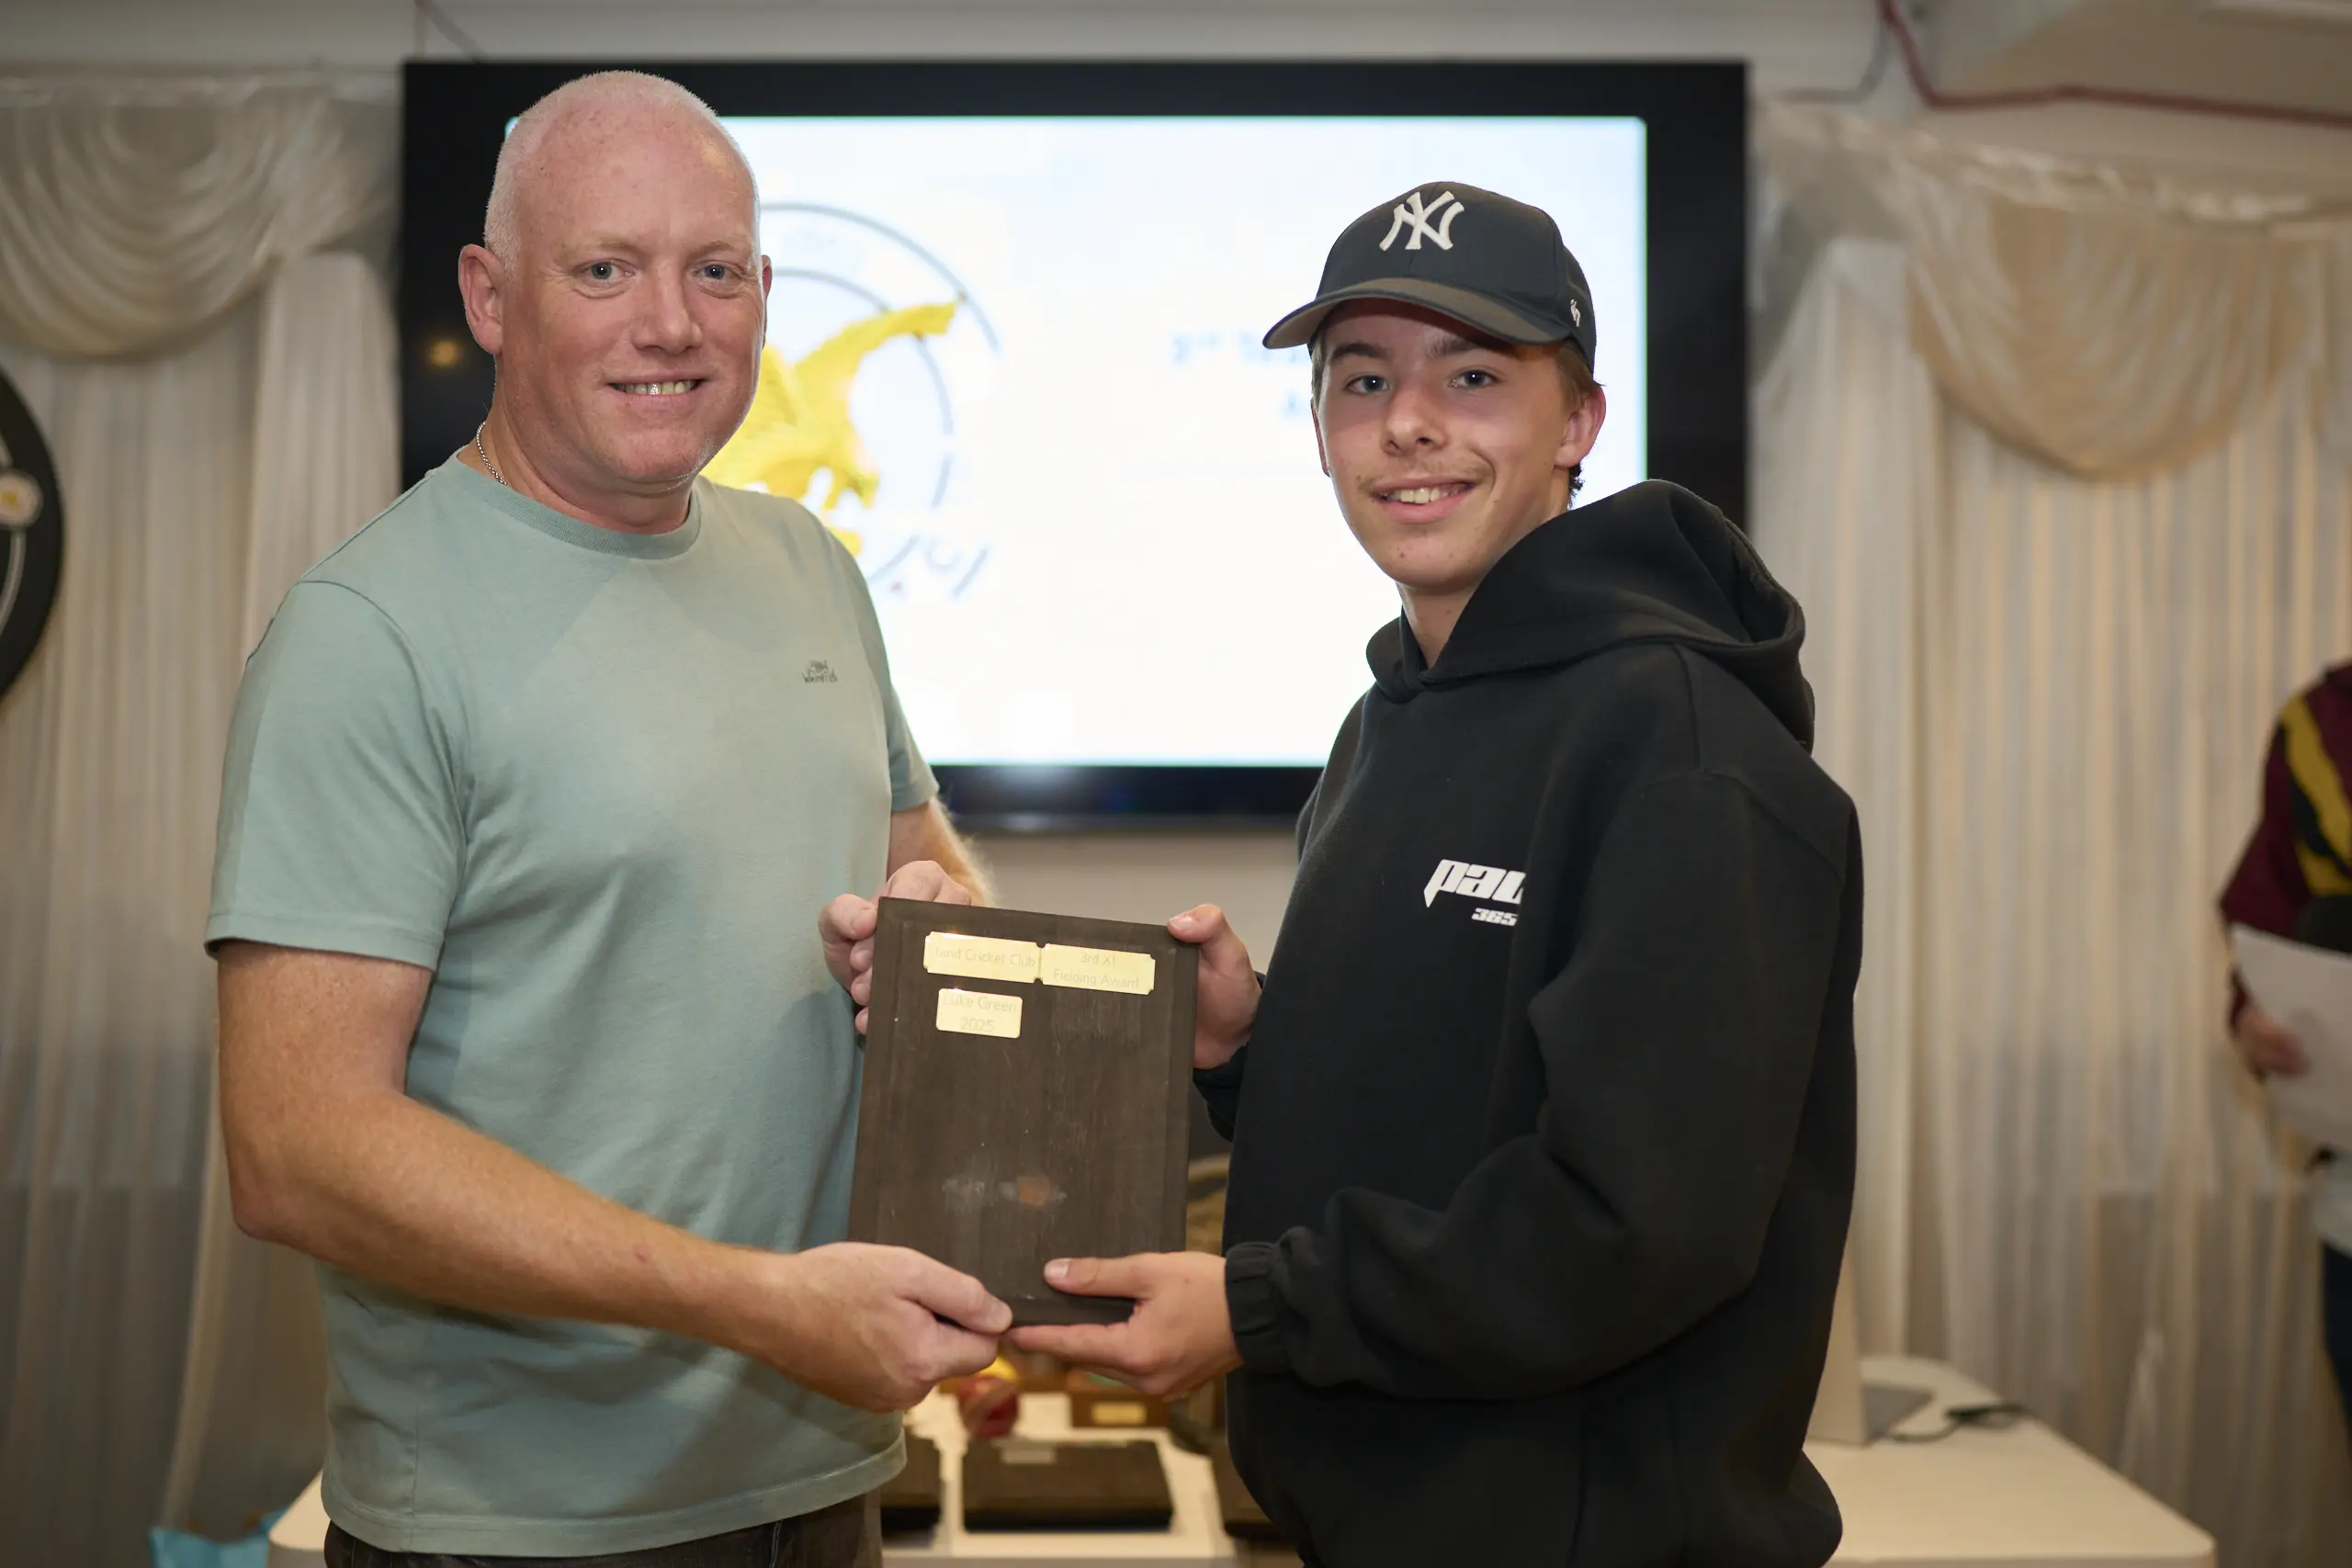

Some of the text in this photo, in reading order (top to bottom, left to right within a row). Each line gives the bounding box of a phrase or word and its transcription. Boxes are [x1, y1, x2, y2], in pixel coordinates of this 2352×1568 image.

[1379, 190, 1464, 251] NY
[1472, 908, 1518, 926] 365
[965, 949, 1005, 964] Cricket
[1010, 953, 1036, 967] Club
[1080, 951, 1099, 964] 3rd
[1054, 968, 1139, 988] Fielding Award
[978, 996, 1017, 1012] Green
[960, 1017, 994, 1032] 2025
